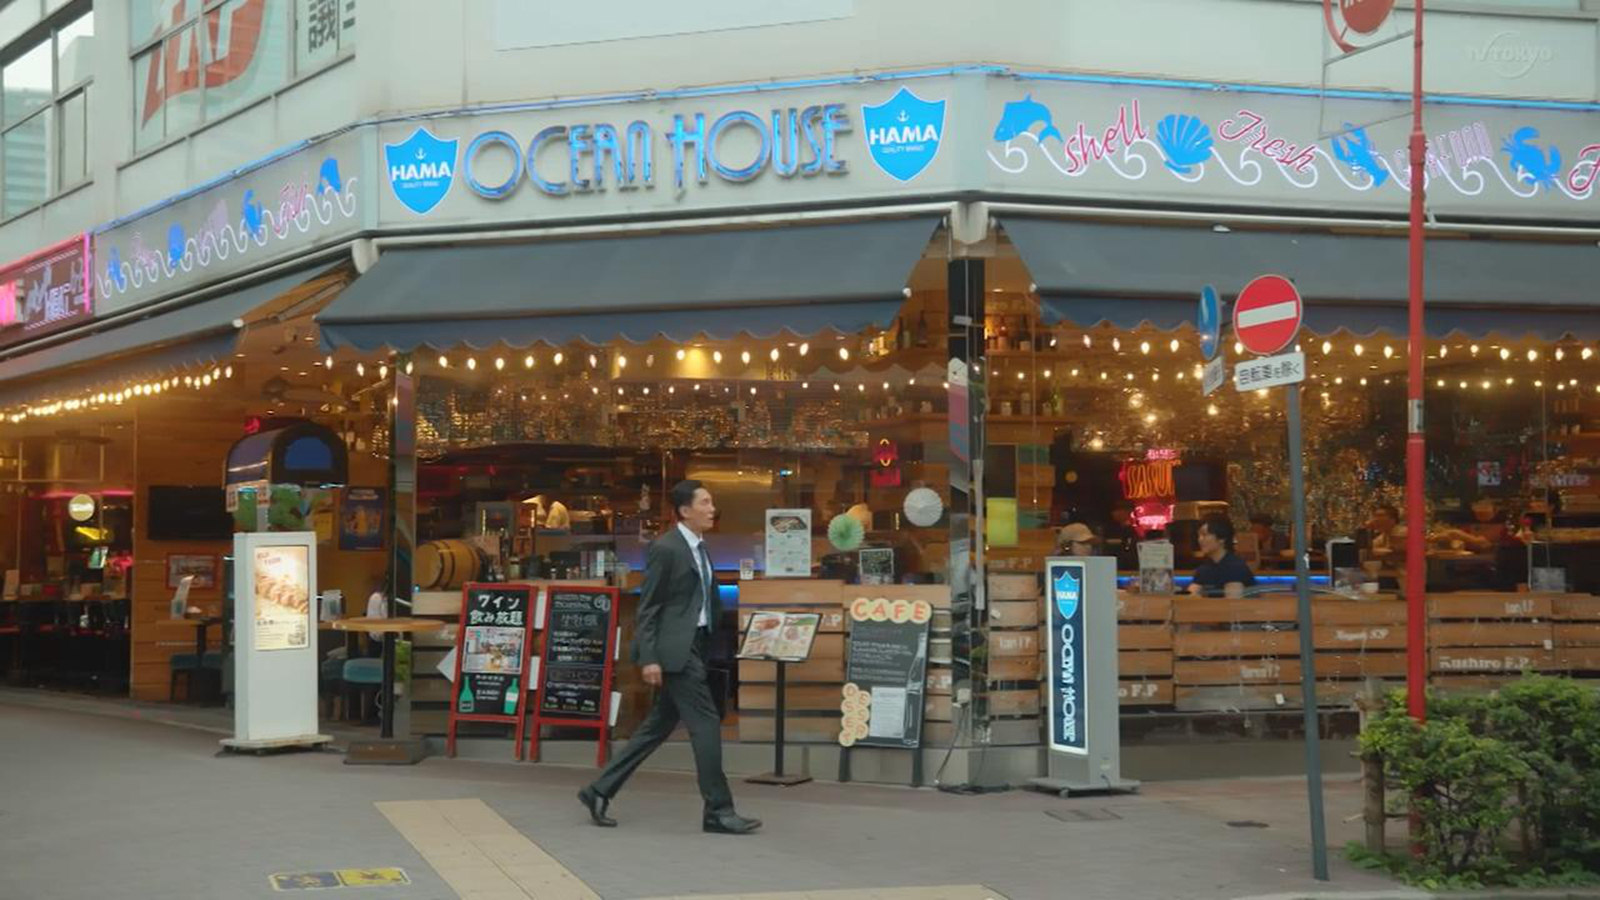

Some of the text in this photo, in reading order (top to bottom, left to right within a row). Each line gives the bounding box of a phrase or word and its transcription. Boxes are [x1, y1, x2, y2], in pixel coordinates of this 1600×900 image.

[869, 125, 938, 145] HAMA
[1064, 98, 1146, 174] shell
[1218, 109, 1319, 173] Fresh
[463, 103, 850, 199] OCEAN HOUSE
[391, 161, 451, 181] HAMA
[1240, 361, 1300, 386] 自転車を除く
[478, 595, 520, 611] ワイン
[853, 602, 928, 621] CAFE
[470, 610, 524, 626] 飲み放題
